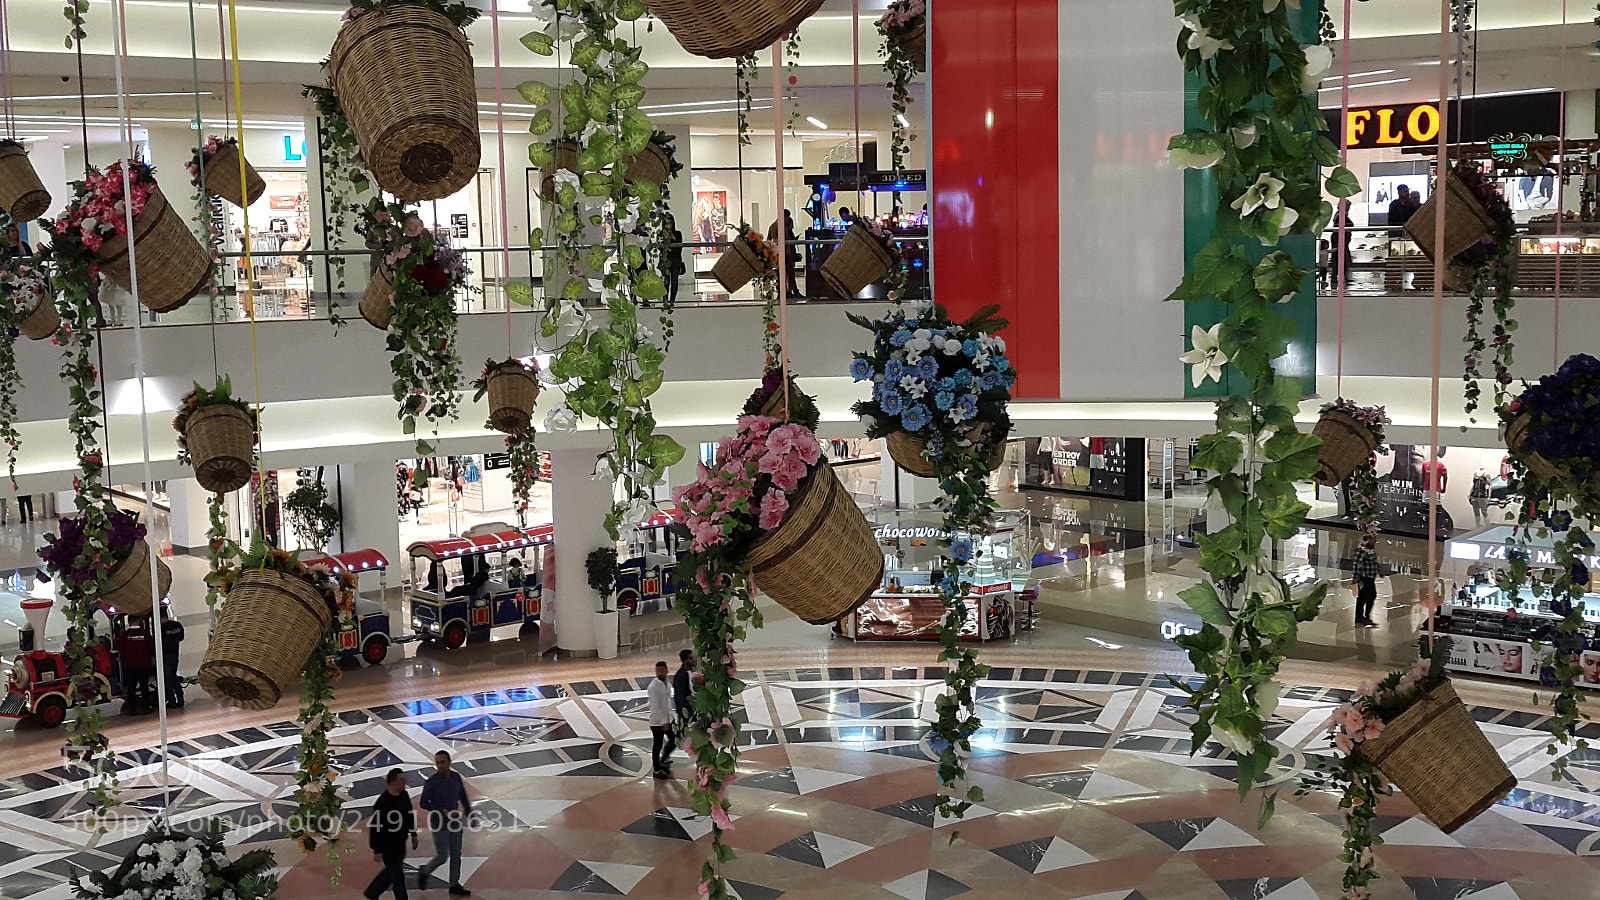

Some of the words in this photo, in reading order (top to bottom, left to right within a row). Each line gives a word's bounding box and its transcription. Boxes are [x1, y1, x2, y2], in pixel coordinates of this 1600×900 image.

[1346, 104, 1440, 146] FLO
[284, 135, 307, 161] L
[1052, 458, 1077, 467] ORDER
[1377, 485, 1424, 497] VERYTHIN
[1391, 479, 1413, 489] WIN
[874, 523, 956, 539] chocowor
